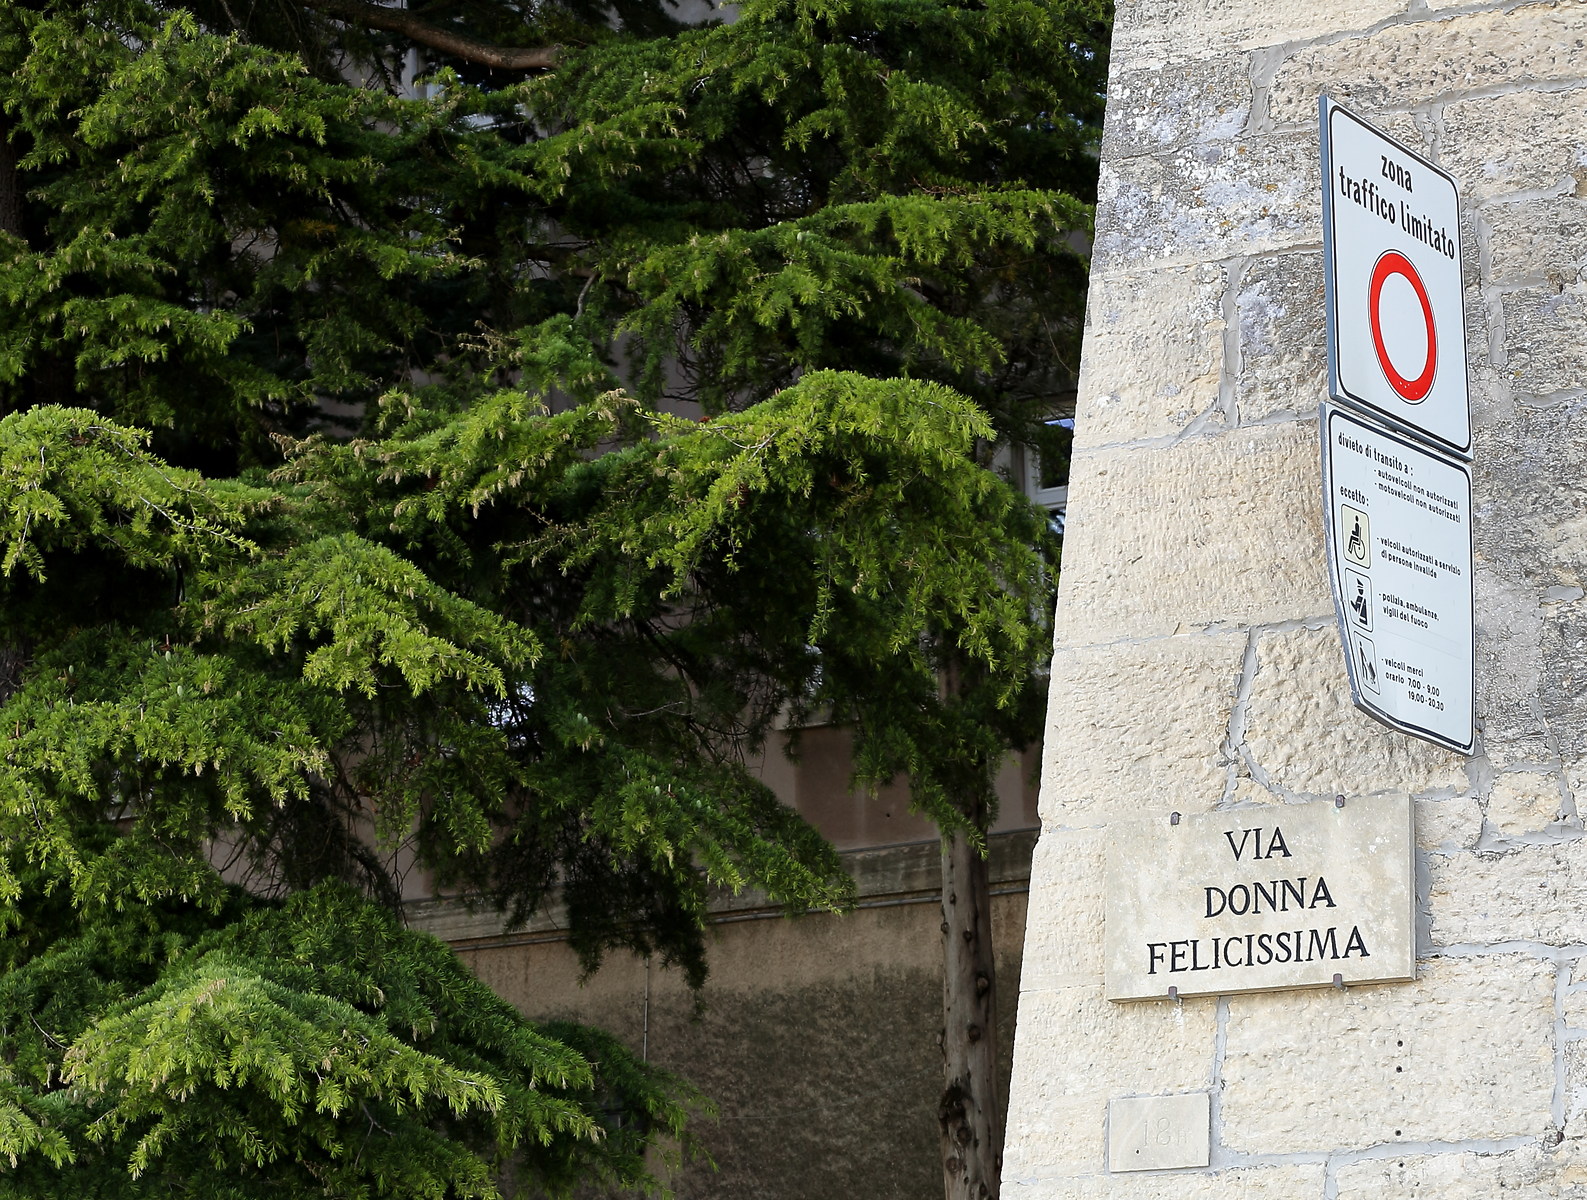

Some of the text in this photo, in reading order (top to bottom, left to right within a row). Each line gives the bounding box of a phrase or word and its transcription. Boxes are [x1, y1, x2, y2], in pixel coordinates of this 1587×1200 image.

[1381, 154, 1413, 193] zona
[1339, 165, 1455, 260] traffico limitato
[1338, 432, 1363, 454] divieto
[1365, 444, 1372, 459] di
[1374, 448, 1403, 472] transito
[1413, 484, 1425, 495] non
[1426, 490, 1459, 510] autorizzati
[1415, 497, 1427, 509] non
[1428, 503, 1461, 523] autorizzati
[1380, 537, 1401, 551] veicoli
[1402, 545, 1434, 564] autorizzati
[1439, 561, 1461, 576] servizio
[1388, 553, 1413, 570] persone
[1384, 658, 1424, 677] veicoli merci
[1385, 671, 1405, 684] orario
[1223, 826, 1293, 862] VIA
[1203, 876, 1337, 919] DONNA
[1146, 925, 1371, 975] FELICISSIMA
